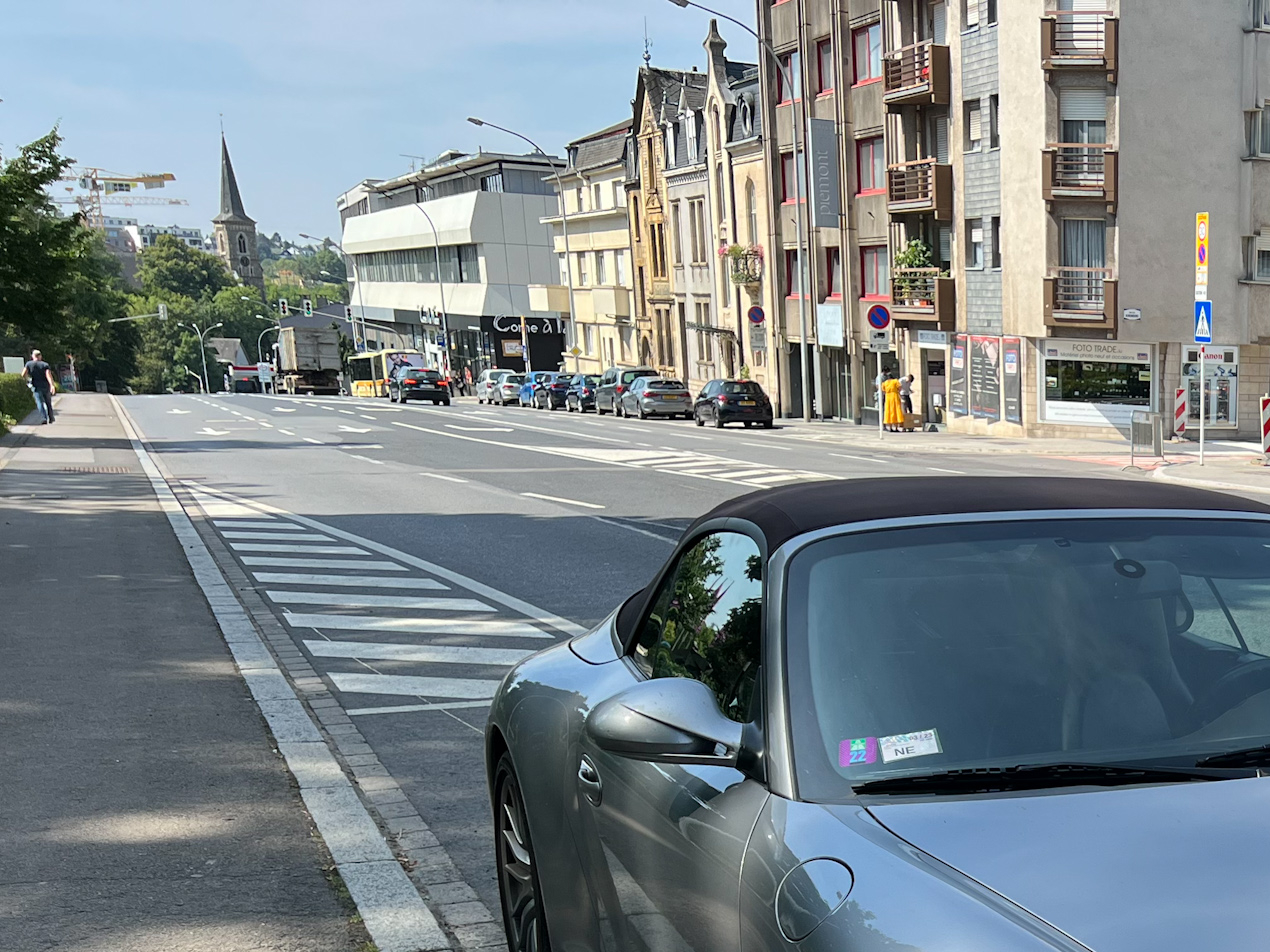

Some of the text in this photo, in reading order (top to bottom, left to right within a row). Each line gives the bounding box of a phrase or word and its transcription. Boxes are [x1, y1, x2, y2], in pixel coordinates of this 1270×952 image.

[542, 318, 553, 333] à
[1072, 344, 1092, 352] FOTO
[849, 750, 866, 763] 22
[894, 746, 916, 756] NE
